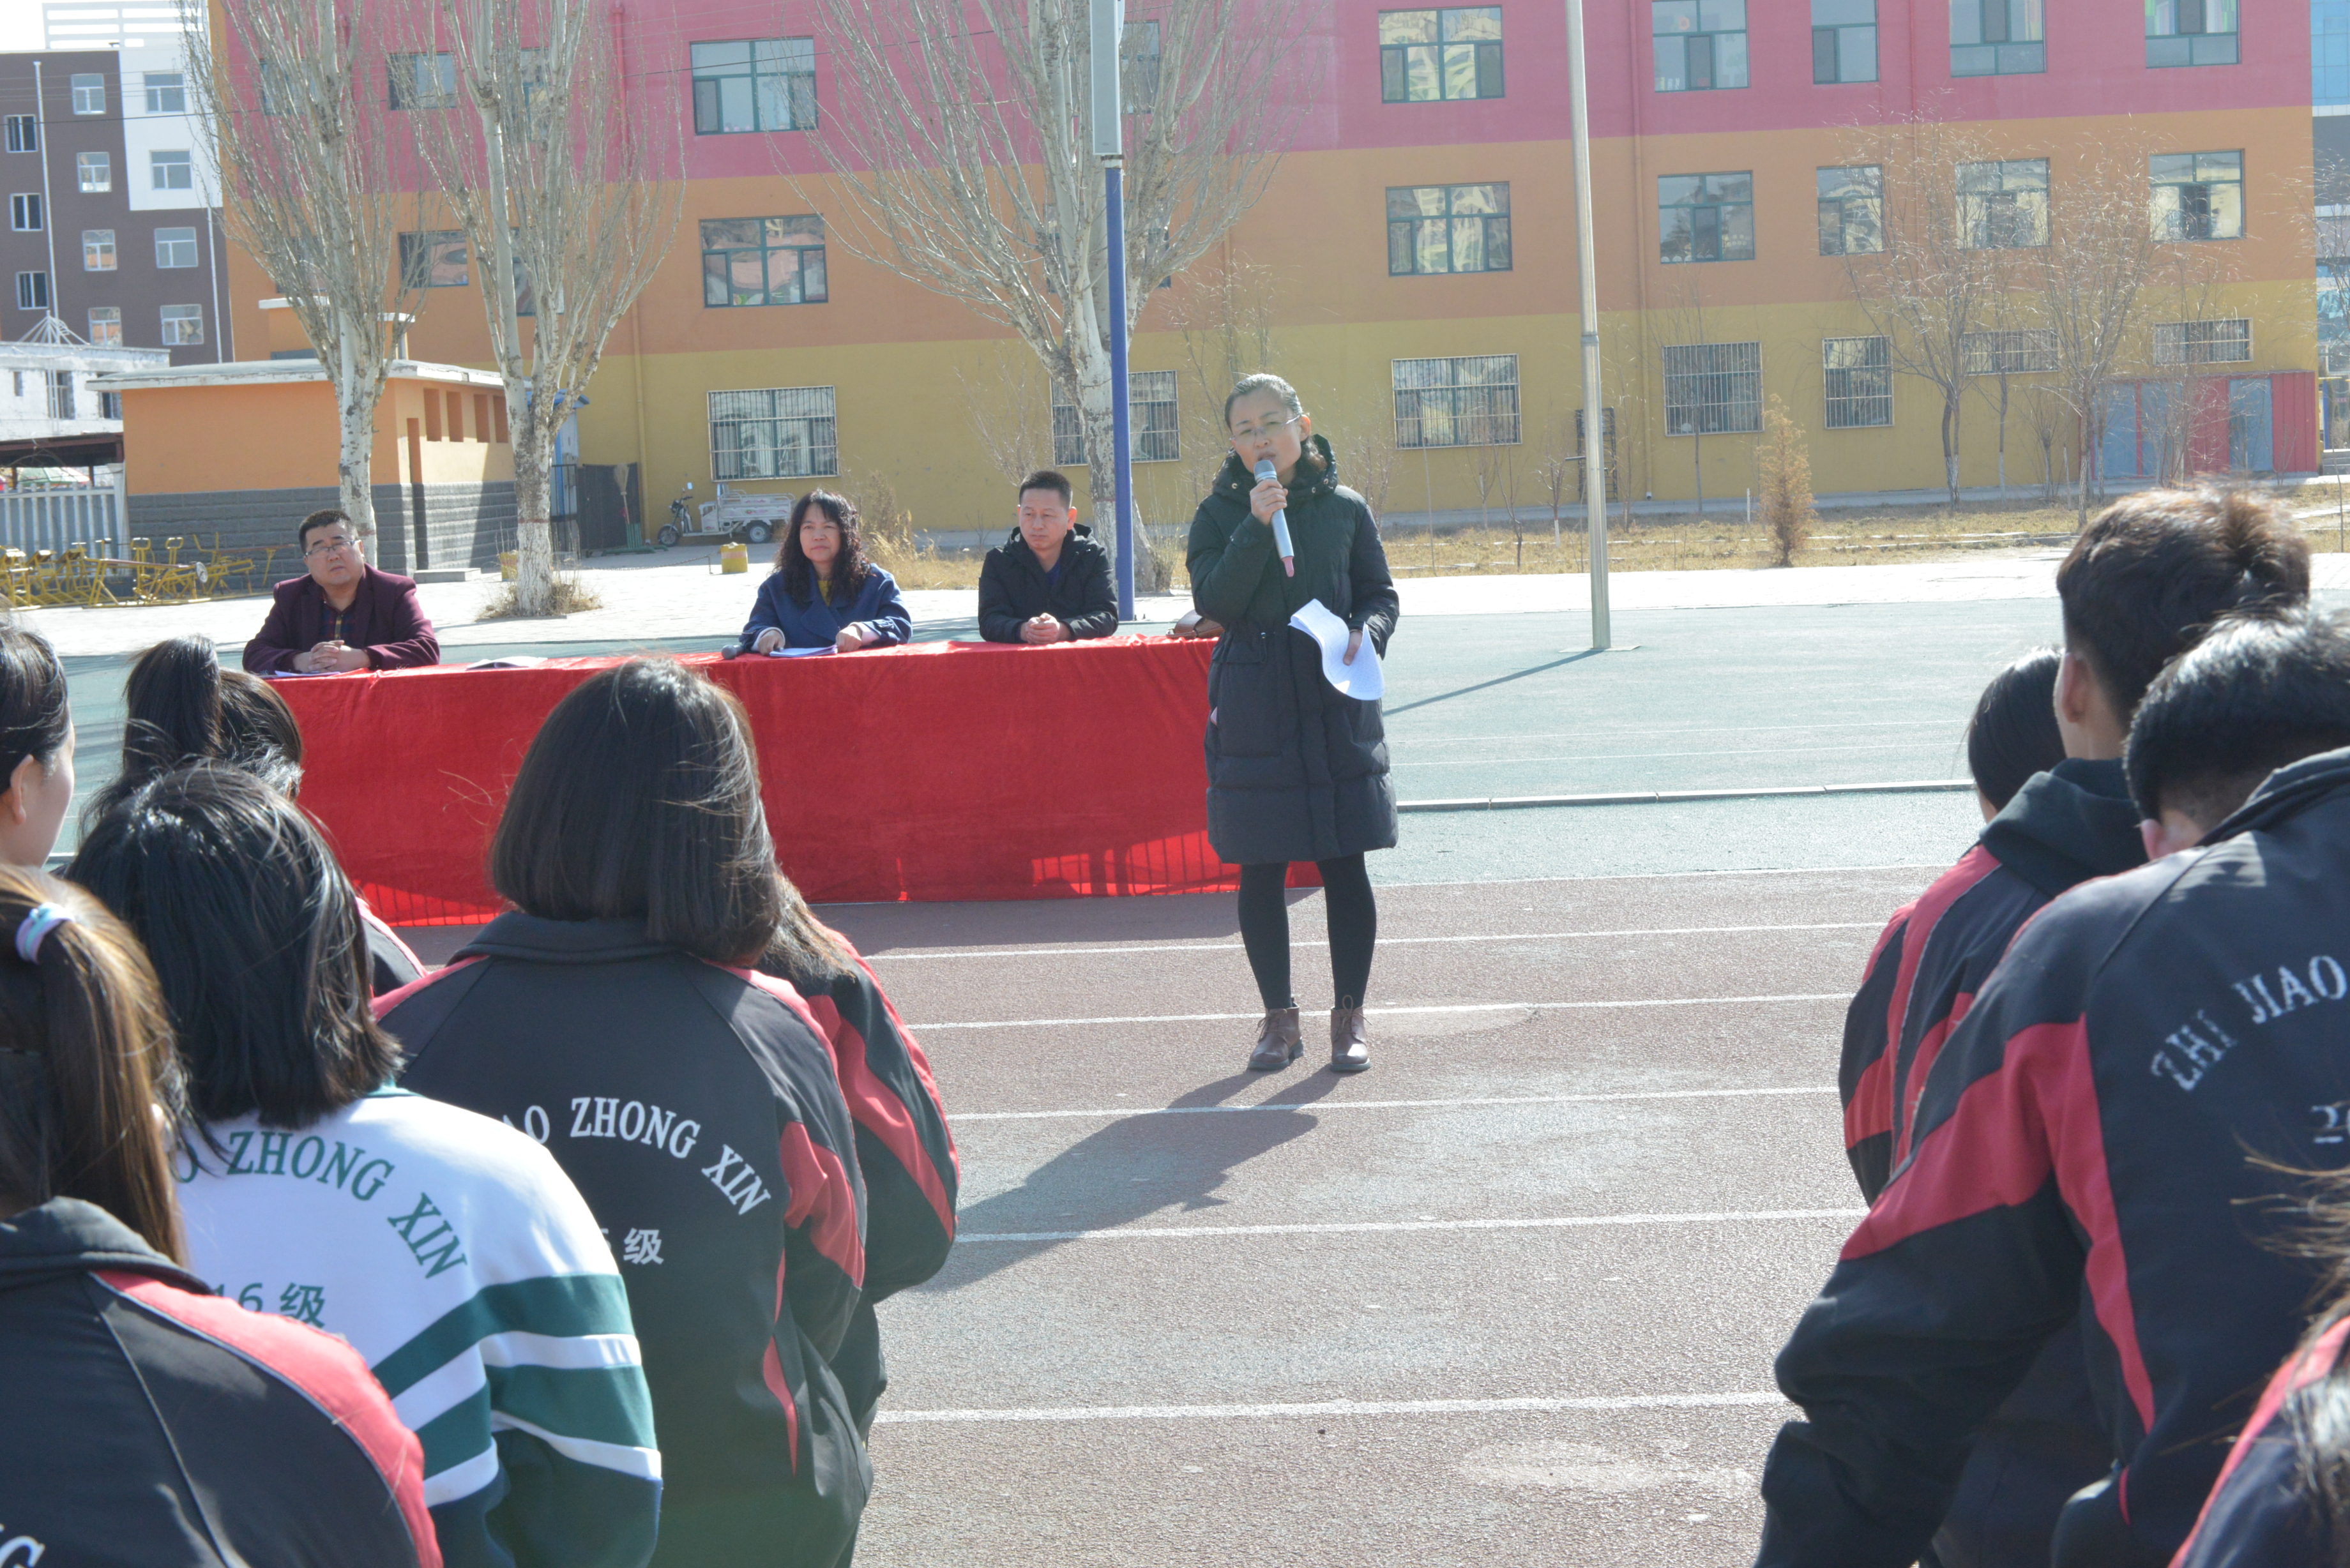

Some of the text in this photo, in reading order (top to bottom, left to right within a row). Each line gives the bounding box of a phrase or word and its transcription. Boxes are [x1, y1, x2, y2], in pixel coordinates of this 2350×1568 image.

[2151, 955, 2347, 1090] ZHI JIAO
[226, 1130, 395, 1201] ZHONG
[387, 1192, 467, 1279] XIN
[503, 1097, 771, 1215] O ZHONG XIN
